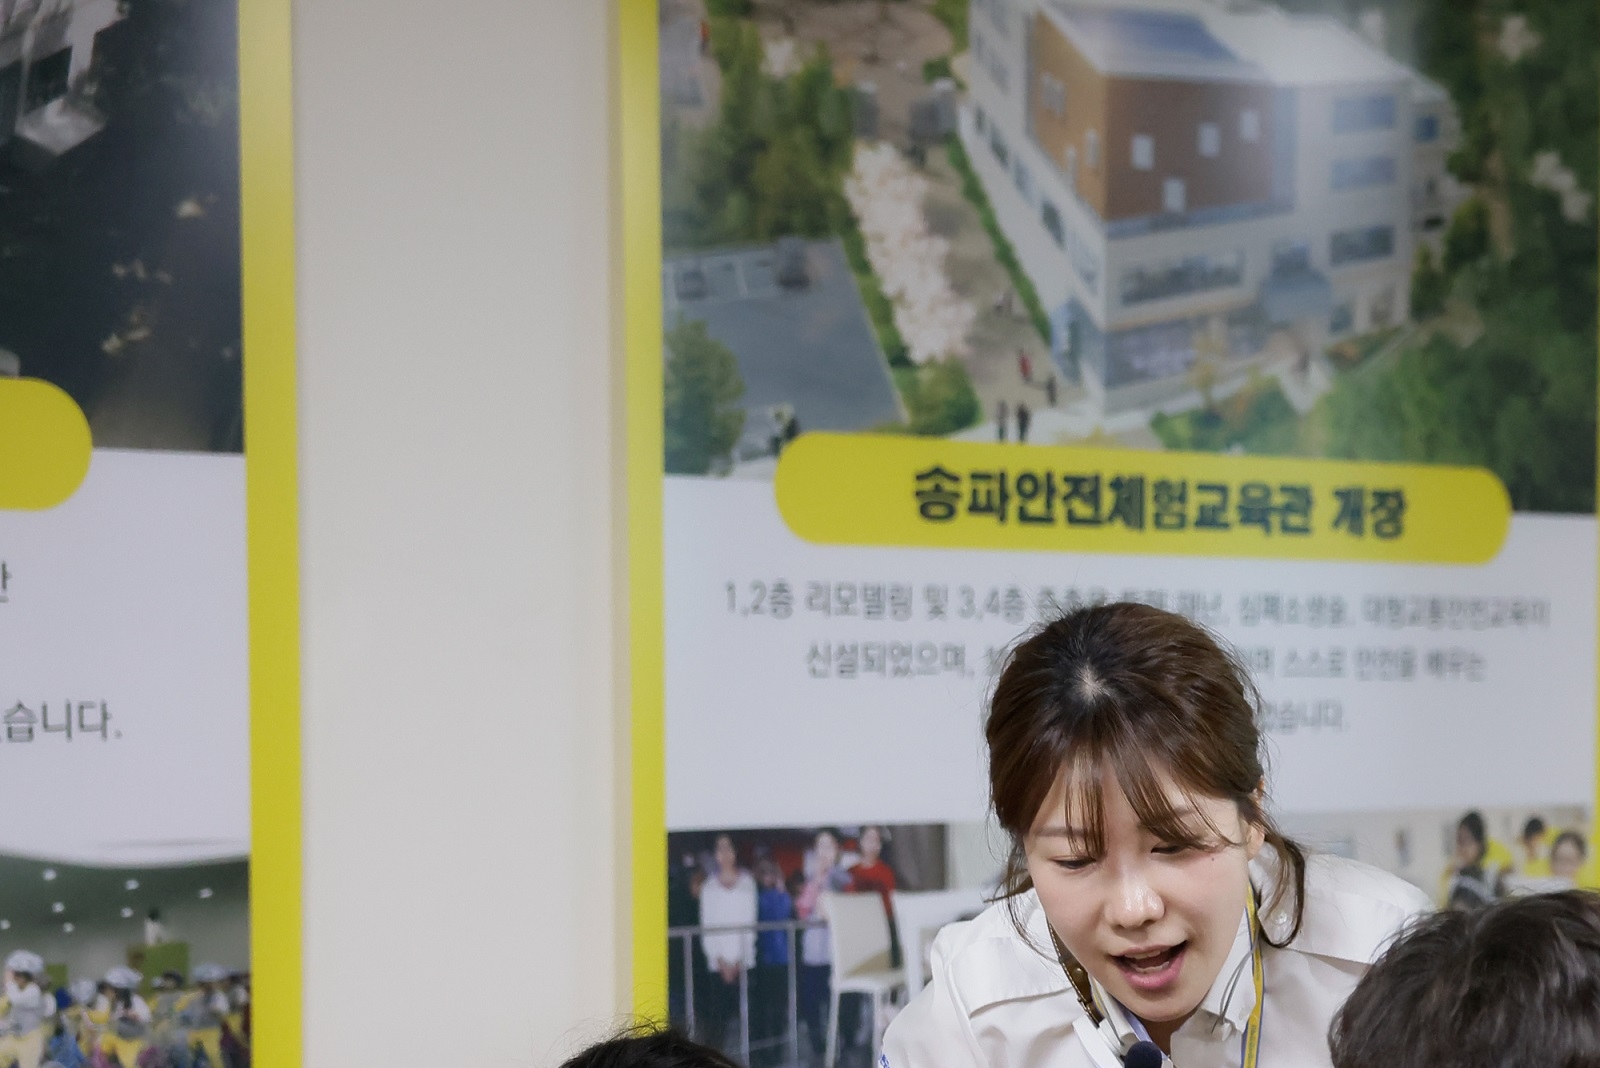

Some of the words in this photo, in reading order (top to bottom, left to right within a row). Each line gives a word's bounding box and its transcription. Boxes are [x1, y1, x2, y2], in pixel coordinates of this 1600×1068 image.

[914, 465, 1315, 535] 송파안전체험교육관
[1331, 486, 1407, 540] 개장
[726, 579, 794, 620] 1,2층
[805, 579, 913, 622] 리모델링
[922, 582, 949, 622] 및
[958, 585, 1026, 624] 3,4층
[807, 641, 975, 679] 신설되었으며,
[0, 699, 122, 742] 습니다.
